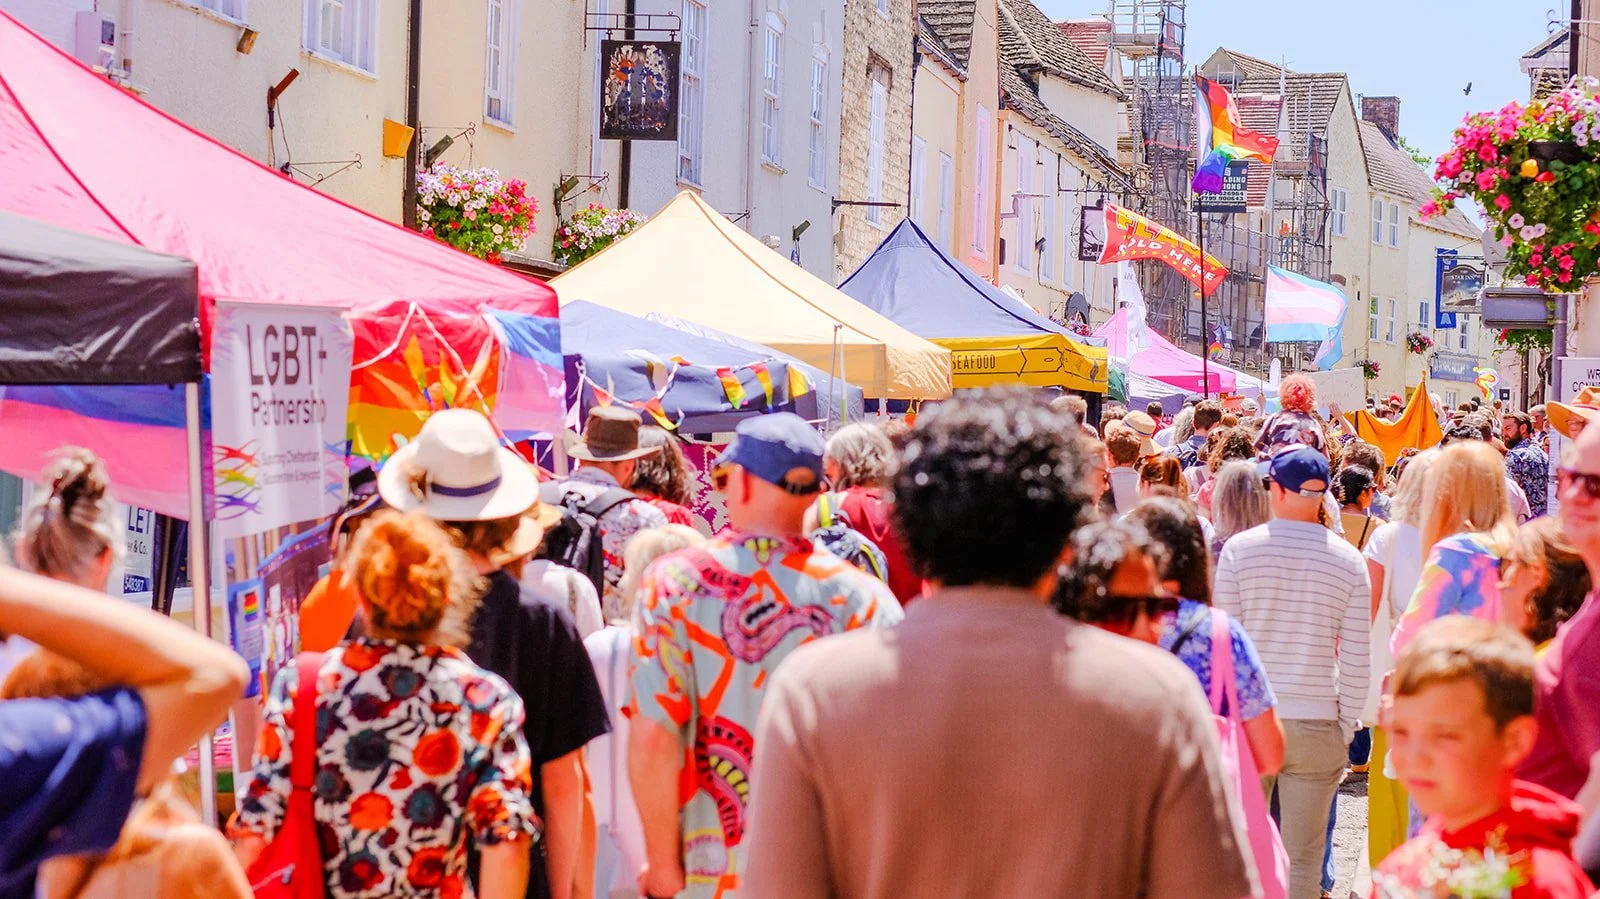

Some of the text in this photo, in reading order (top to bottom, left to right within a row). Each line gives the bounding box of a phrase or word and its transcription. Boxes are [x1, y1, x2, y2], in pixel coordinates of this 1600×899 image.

[1169, 249, 1216, 282] HERE
[246, 324, 327, 386] LGBT+
[952, 354, 996, 370] SEAFOOD
[251, 389, 327, 427] Partnershp
[128, 506, 152, 534] LET
